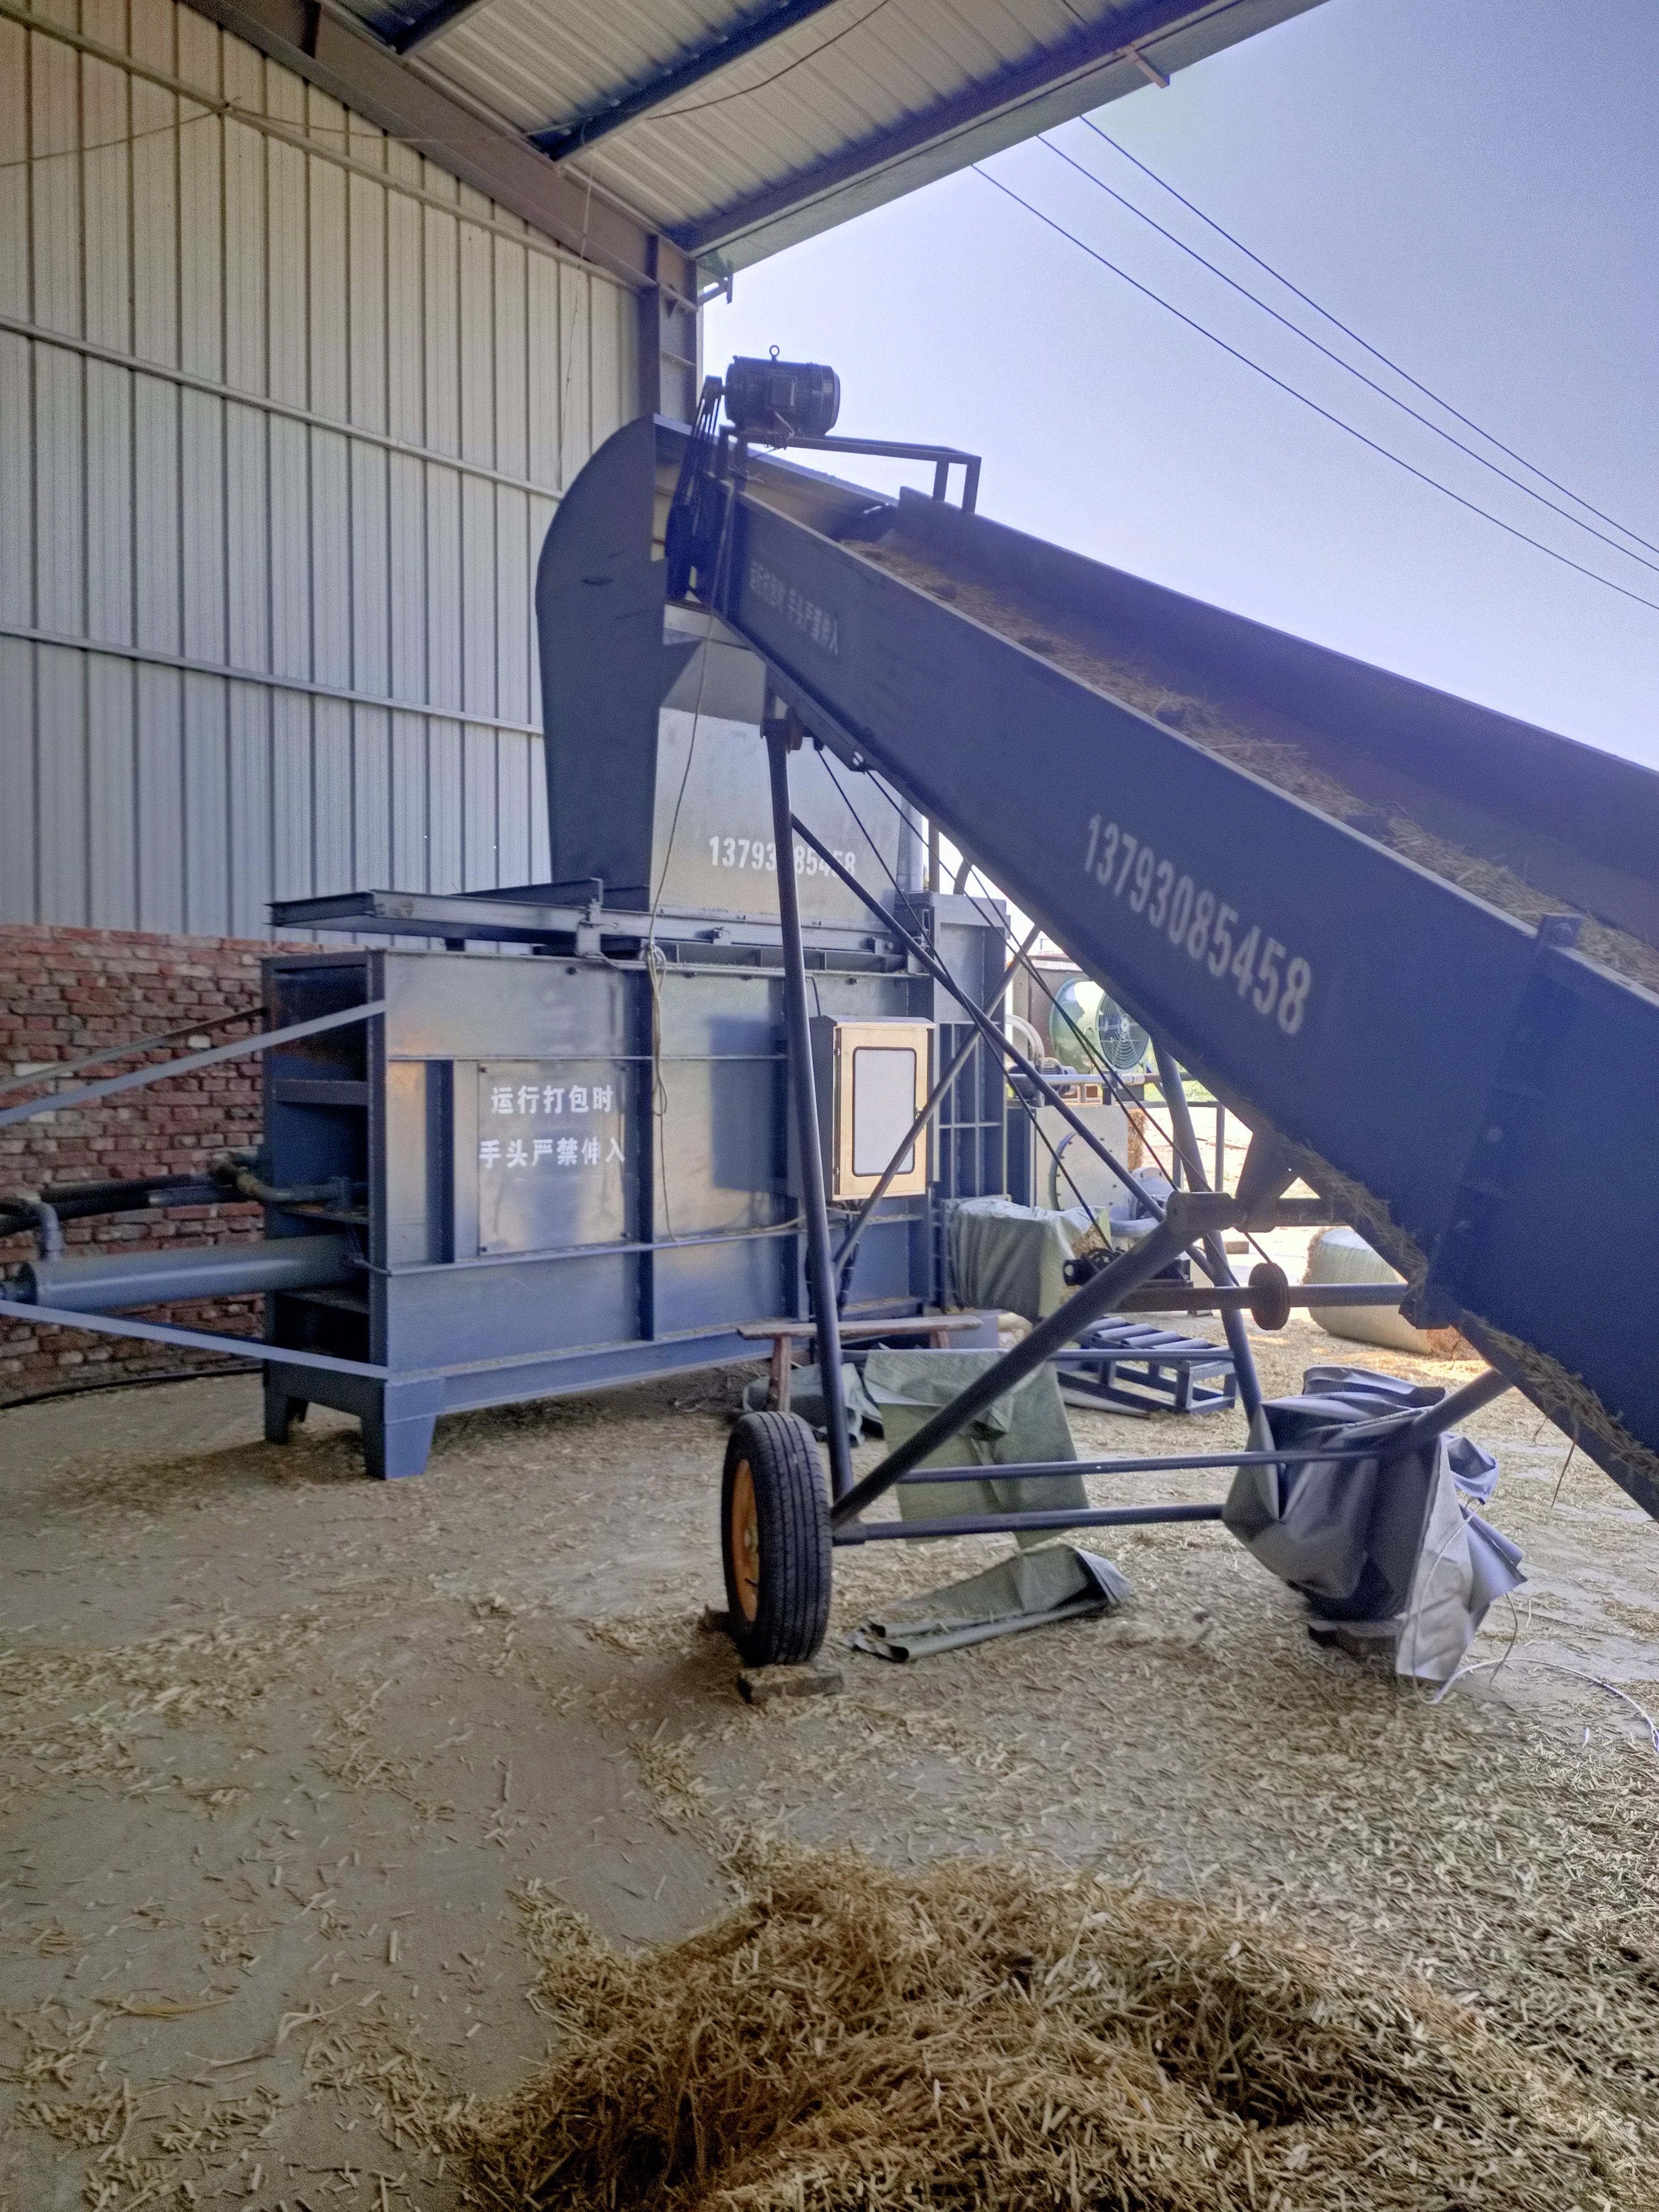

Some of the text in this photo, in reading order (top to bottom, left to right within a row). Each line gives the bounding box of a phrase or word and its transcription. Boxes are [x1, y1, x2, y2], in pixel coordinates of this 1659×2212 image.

[709, 837, 856, 878] 137938548
[1084, 814, 1311, 1035] 13793085458
[491, 1084, 613, 1114] 运行打包时
[479, 1138, 625, 1169] 手头严禁伸入
